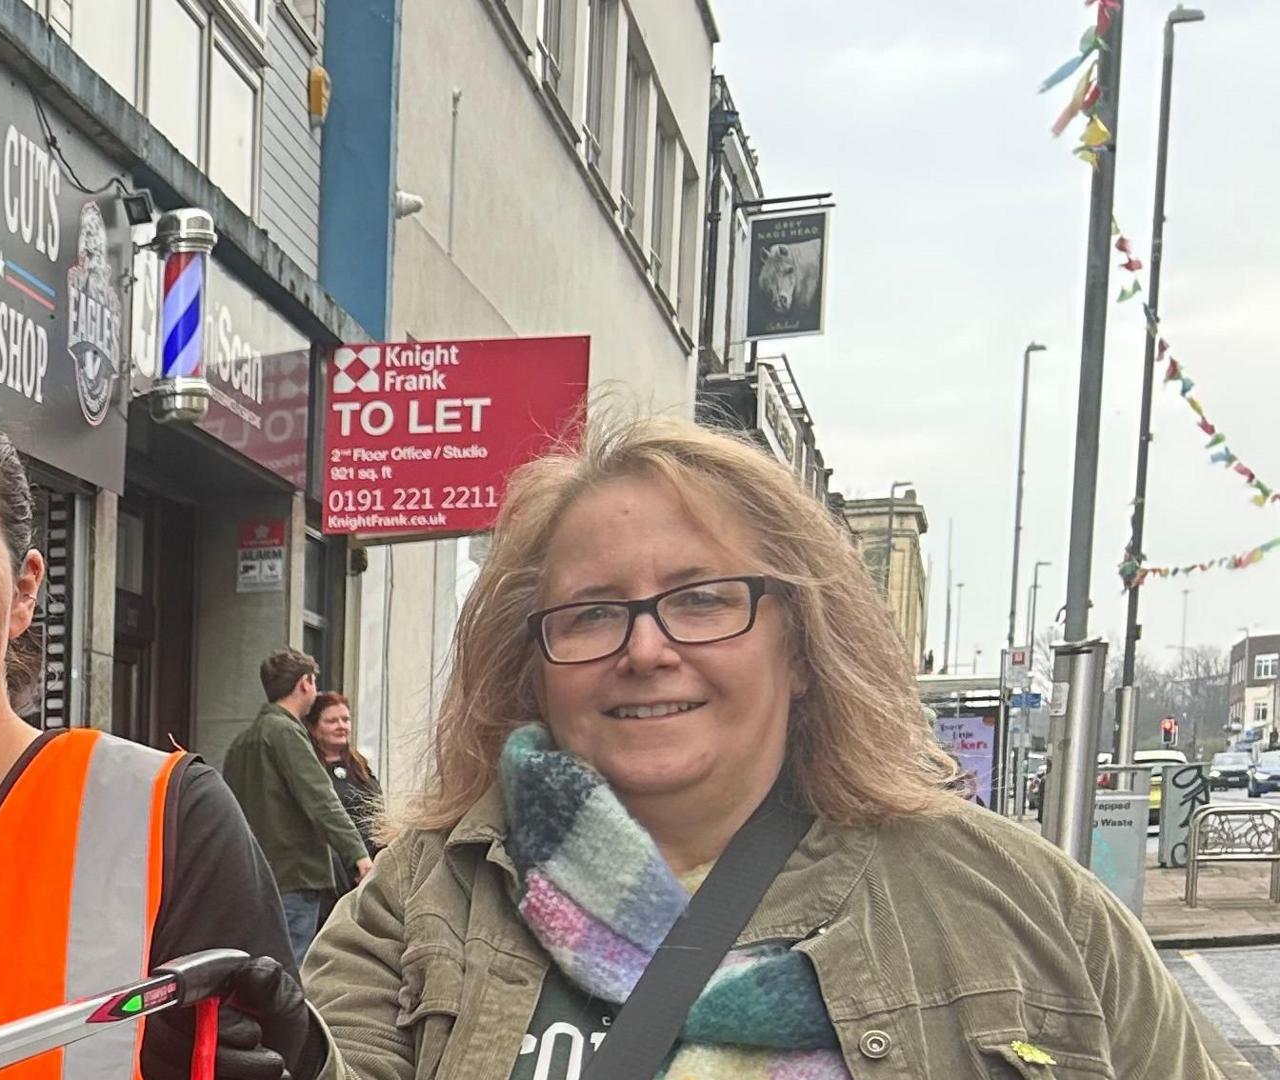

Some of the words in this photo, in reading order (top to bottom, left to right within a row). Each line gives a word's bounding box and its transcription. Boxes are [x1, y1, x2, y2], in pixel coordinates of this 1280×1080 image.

[4, 124, 60, 263] CUTS
[385, 344, 459, 372] Knight
[385, 370, 446, 392] Frank
[332, 400, 395, 437] TO
[408, 397, 491, 434] LET
[353, 448, 389, 462] Floor
[390, 446, 432, 461] Office
[443, 445, 488, 459] Studio
[330, 467, 354, 480] 921
[381, 466, 393, 480] ft
[328, 489, 384, 512] 0191
[393, 487, 434, 511] 221
[441, 485, 498, 509] 2211
[328, 511, 447, 529] KnightFrank.co.uk
[1093, 801, 1131, 812] rapped
[1101, 818, 1133, 827] Waste
